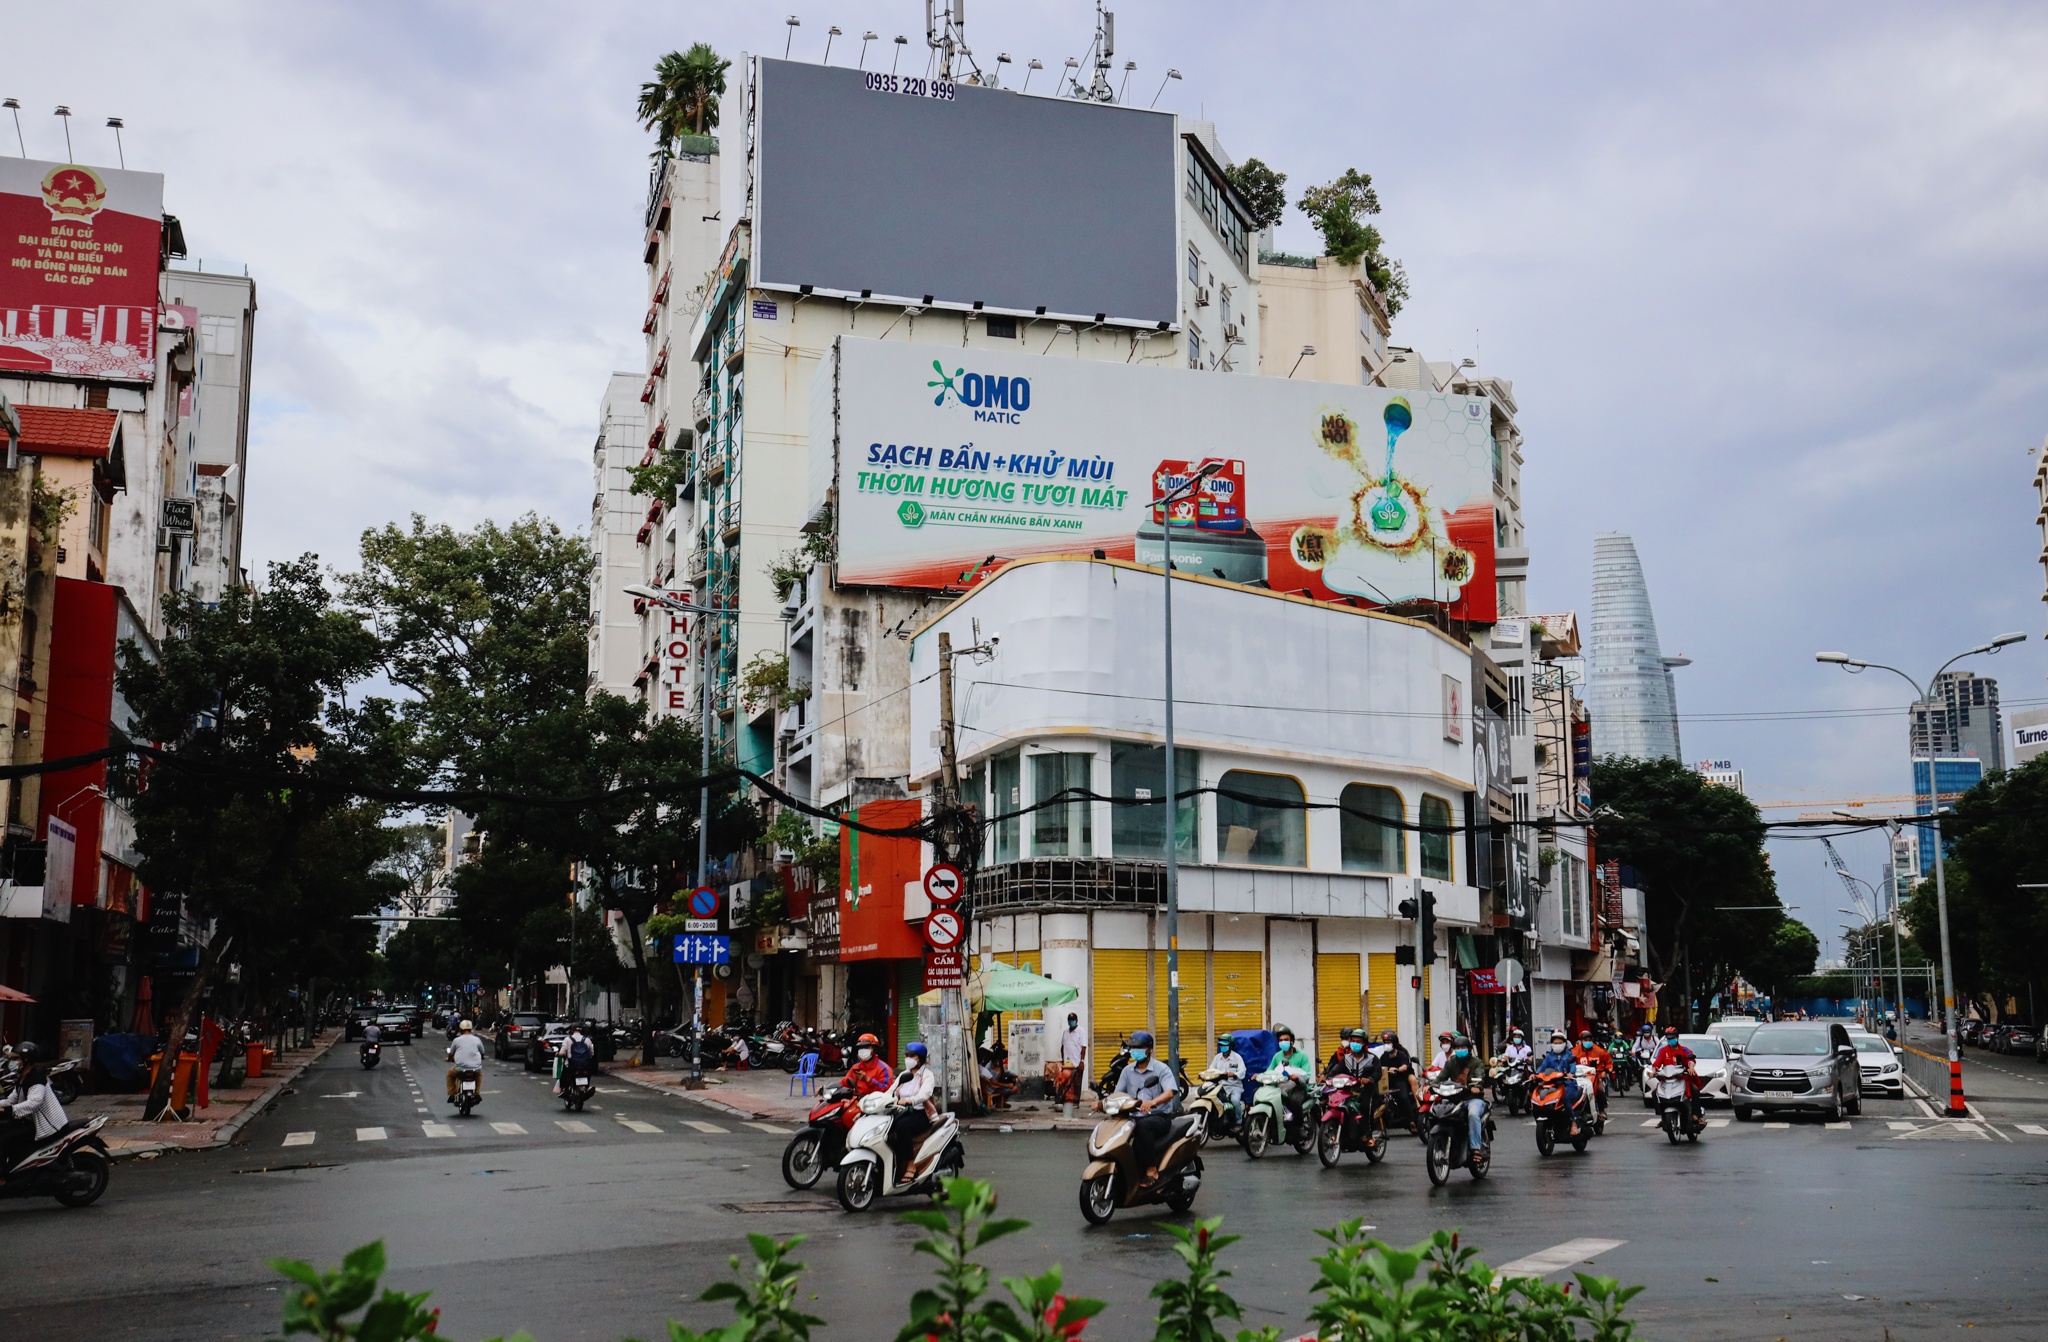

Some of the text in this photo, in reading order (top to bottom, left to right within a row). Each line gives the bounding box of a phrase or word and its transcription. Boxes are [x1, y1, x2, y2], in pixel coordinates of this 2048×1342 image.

[866, 72, 955, 100] 0935 220 999
[18, 235, 123, 254] ĐẠI BIỂU QUỐC HỘI
[38, 248, 103, 262] VÀ ĐẠI BIỂU
[12, 257, 31, 269] HỘI
[69, 264, 101, 274] NHÂN
[104, 266, 128, 276] DÂN
[45, 272, 94, 285] CÁC CẤP
[963, 372, 1030, 411] OMO
[974, 410, 1020, 425] MATIC
[867, 443, 933, 470] SẠCH
[1067, 455, 1114, 480] MÙI
[857, 472, 1128, 507] THƠM HƯƠNG TƯƠI MÁT
[1210, 480, 1234, 494] OMO
[166, 502, 187, 513] Flat
[166, 515, 191, 526] White
[930, 510, 955, 521] MÀN
[990, 514, 1026, 526] KHÁNG
[1053, 519, 1083, 529] XANH
[1142, 550, 1202, 564] Pansonic
[669, 616, 688, 708] HOTE
[1714, 761, 1731, 769] MB
[155, 908, 178, 916] Teas
[150, 925, 176, 934] Cake
[933, 954, 955, 965] CẤM
